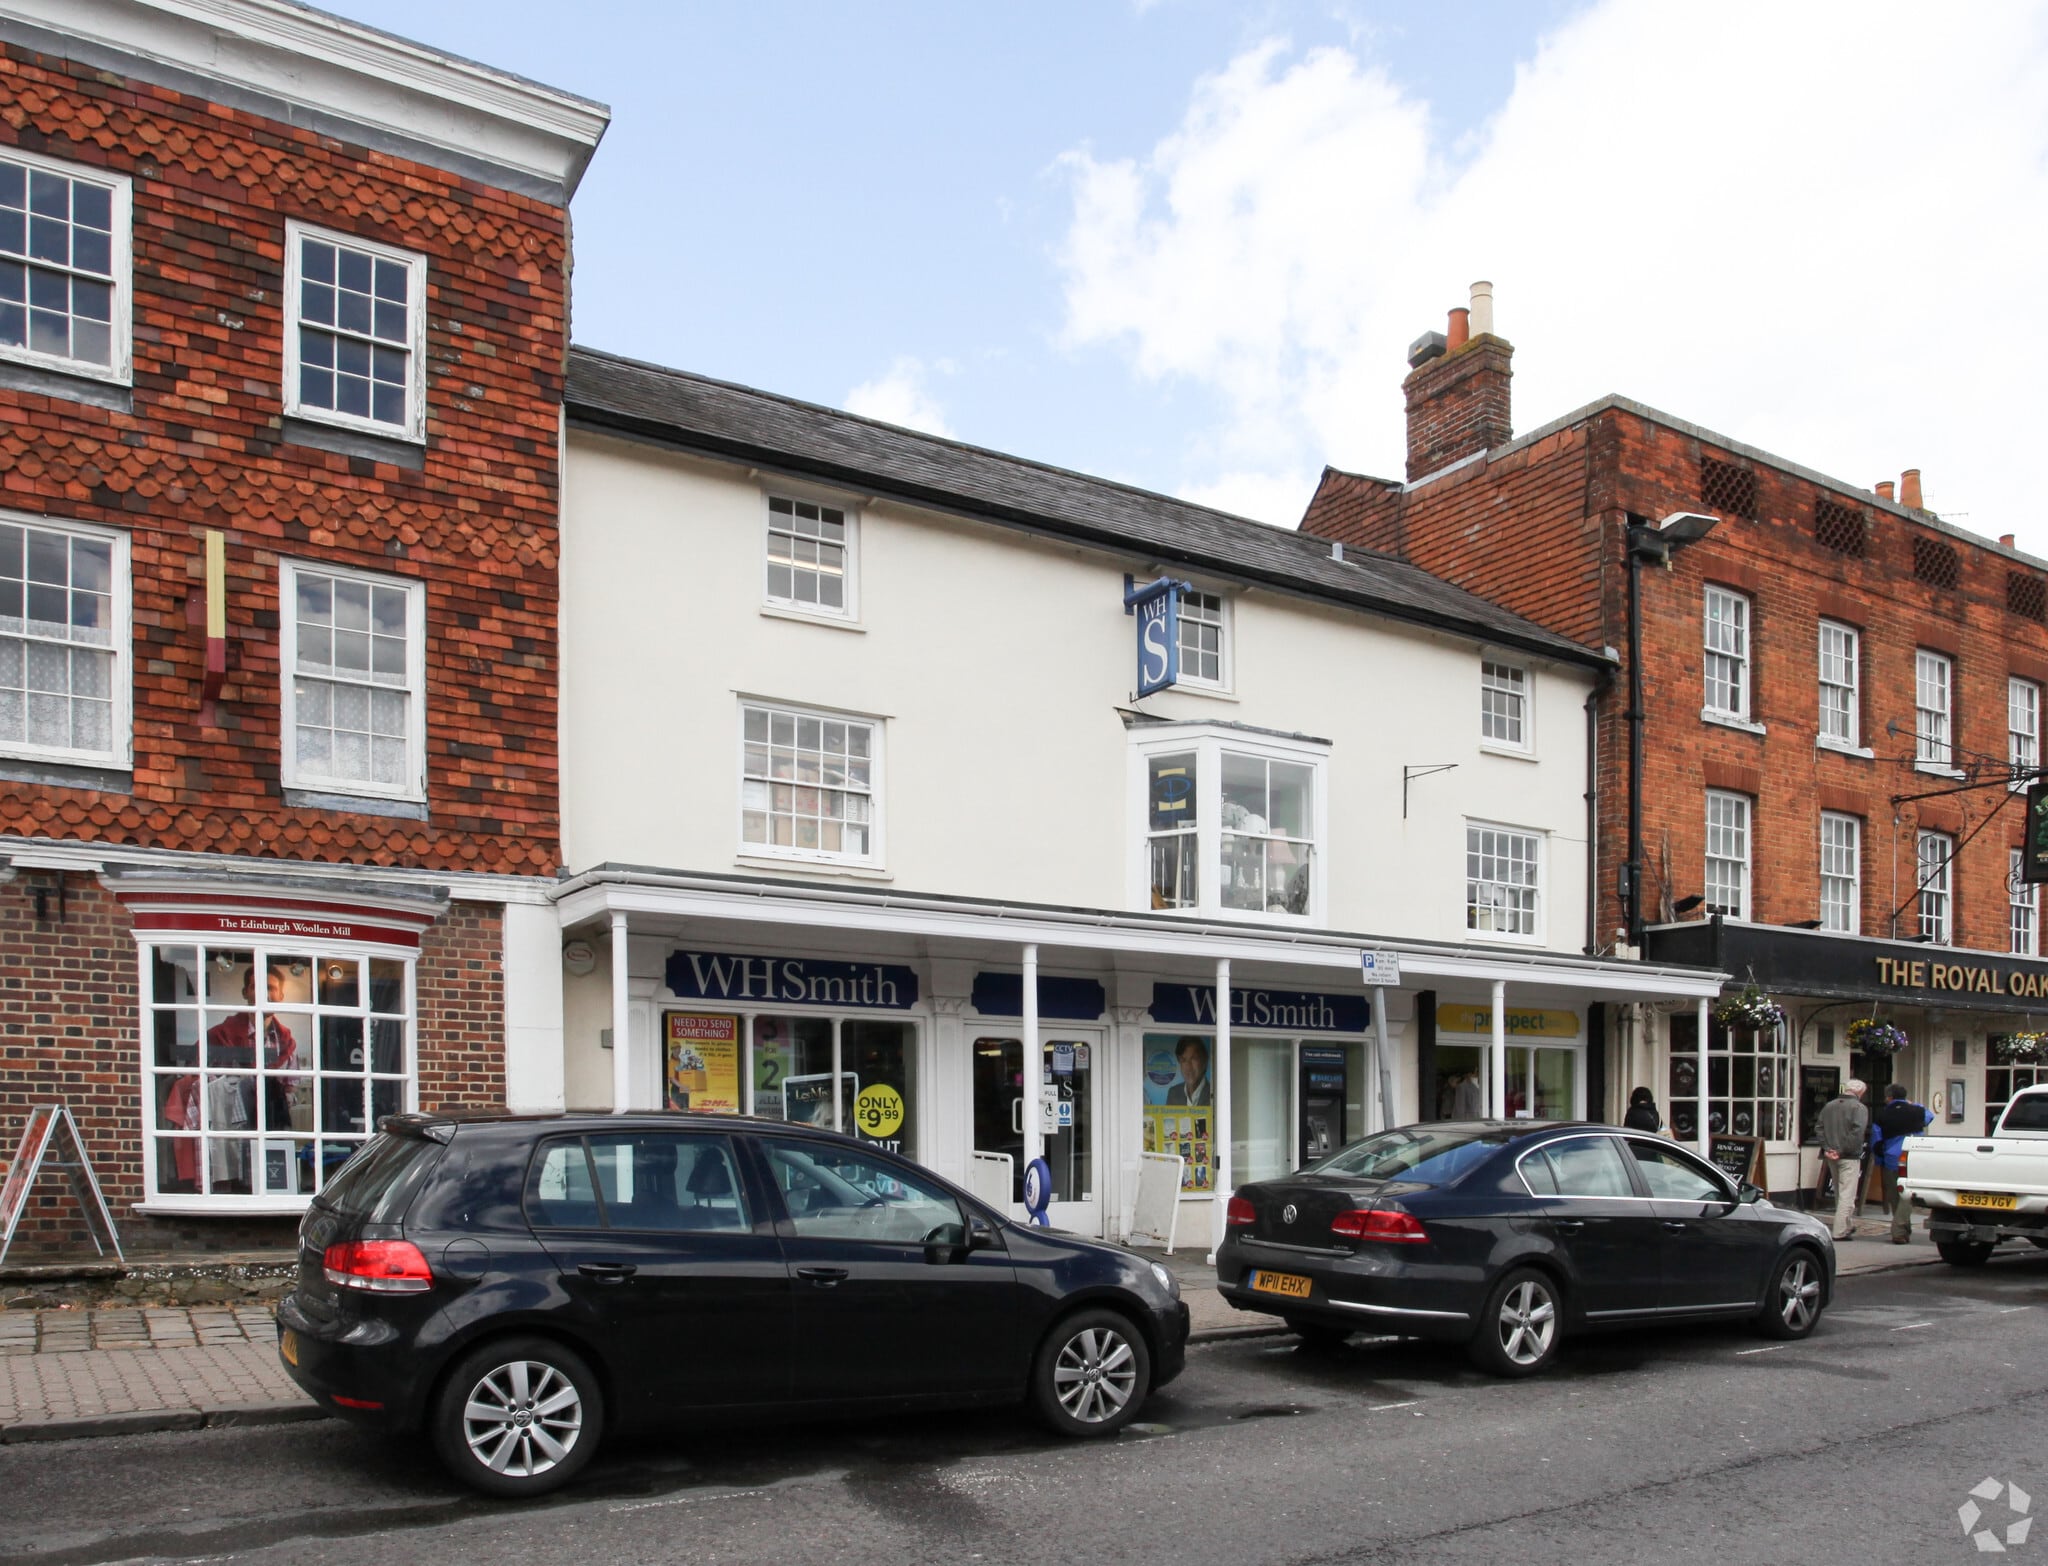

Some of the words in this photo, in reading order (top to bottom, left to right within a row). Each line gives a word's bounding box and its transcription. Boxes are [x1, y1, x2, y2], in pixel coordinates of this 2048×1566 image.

[1144, 595, 1166, 621] WH
[1144, 616, 1168, 686] S
[218, 918, 238, 929] The
[240, 919, 290, 933] Edinburgh
[292, 922, 331, 935] Woollen
[332, 926, 351, 936] Mill
[686, 953, 900, 1006] WHSmith
[1875, 956, 1925, 987] THE
[1931, 962, 2005, 995] ROYAL
[673, 1018, 696, 1027] NEED
[697, 1019, 708, 1028] TO
[709, 1019, 732, 1029] SEND
[676, 1027, 730, 1038] SOMETHING?
[1474, 1011, 1545, 1034] prspect
[1055, 1044, 1073, 1053] CCTV
[761, 1059, 780, 1091] 2
[858, 1096, 899, 1109] ONLY
[1960, 1194, 1988, 1206] S993
[1990, 1195, 2013, 1207] VGV
[1259, 1272, 1280, 1289] WP11
[1281, 1276, 1305, 1294] EHX
